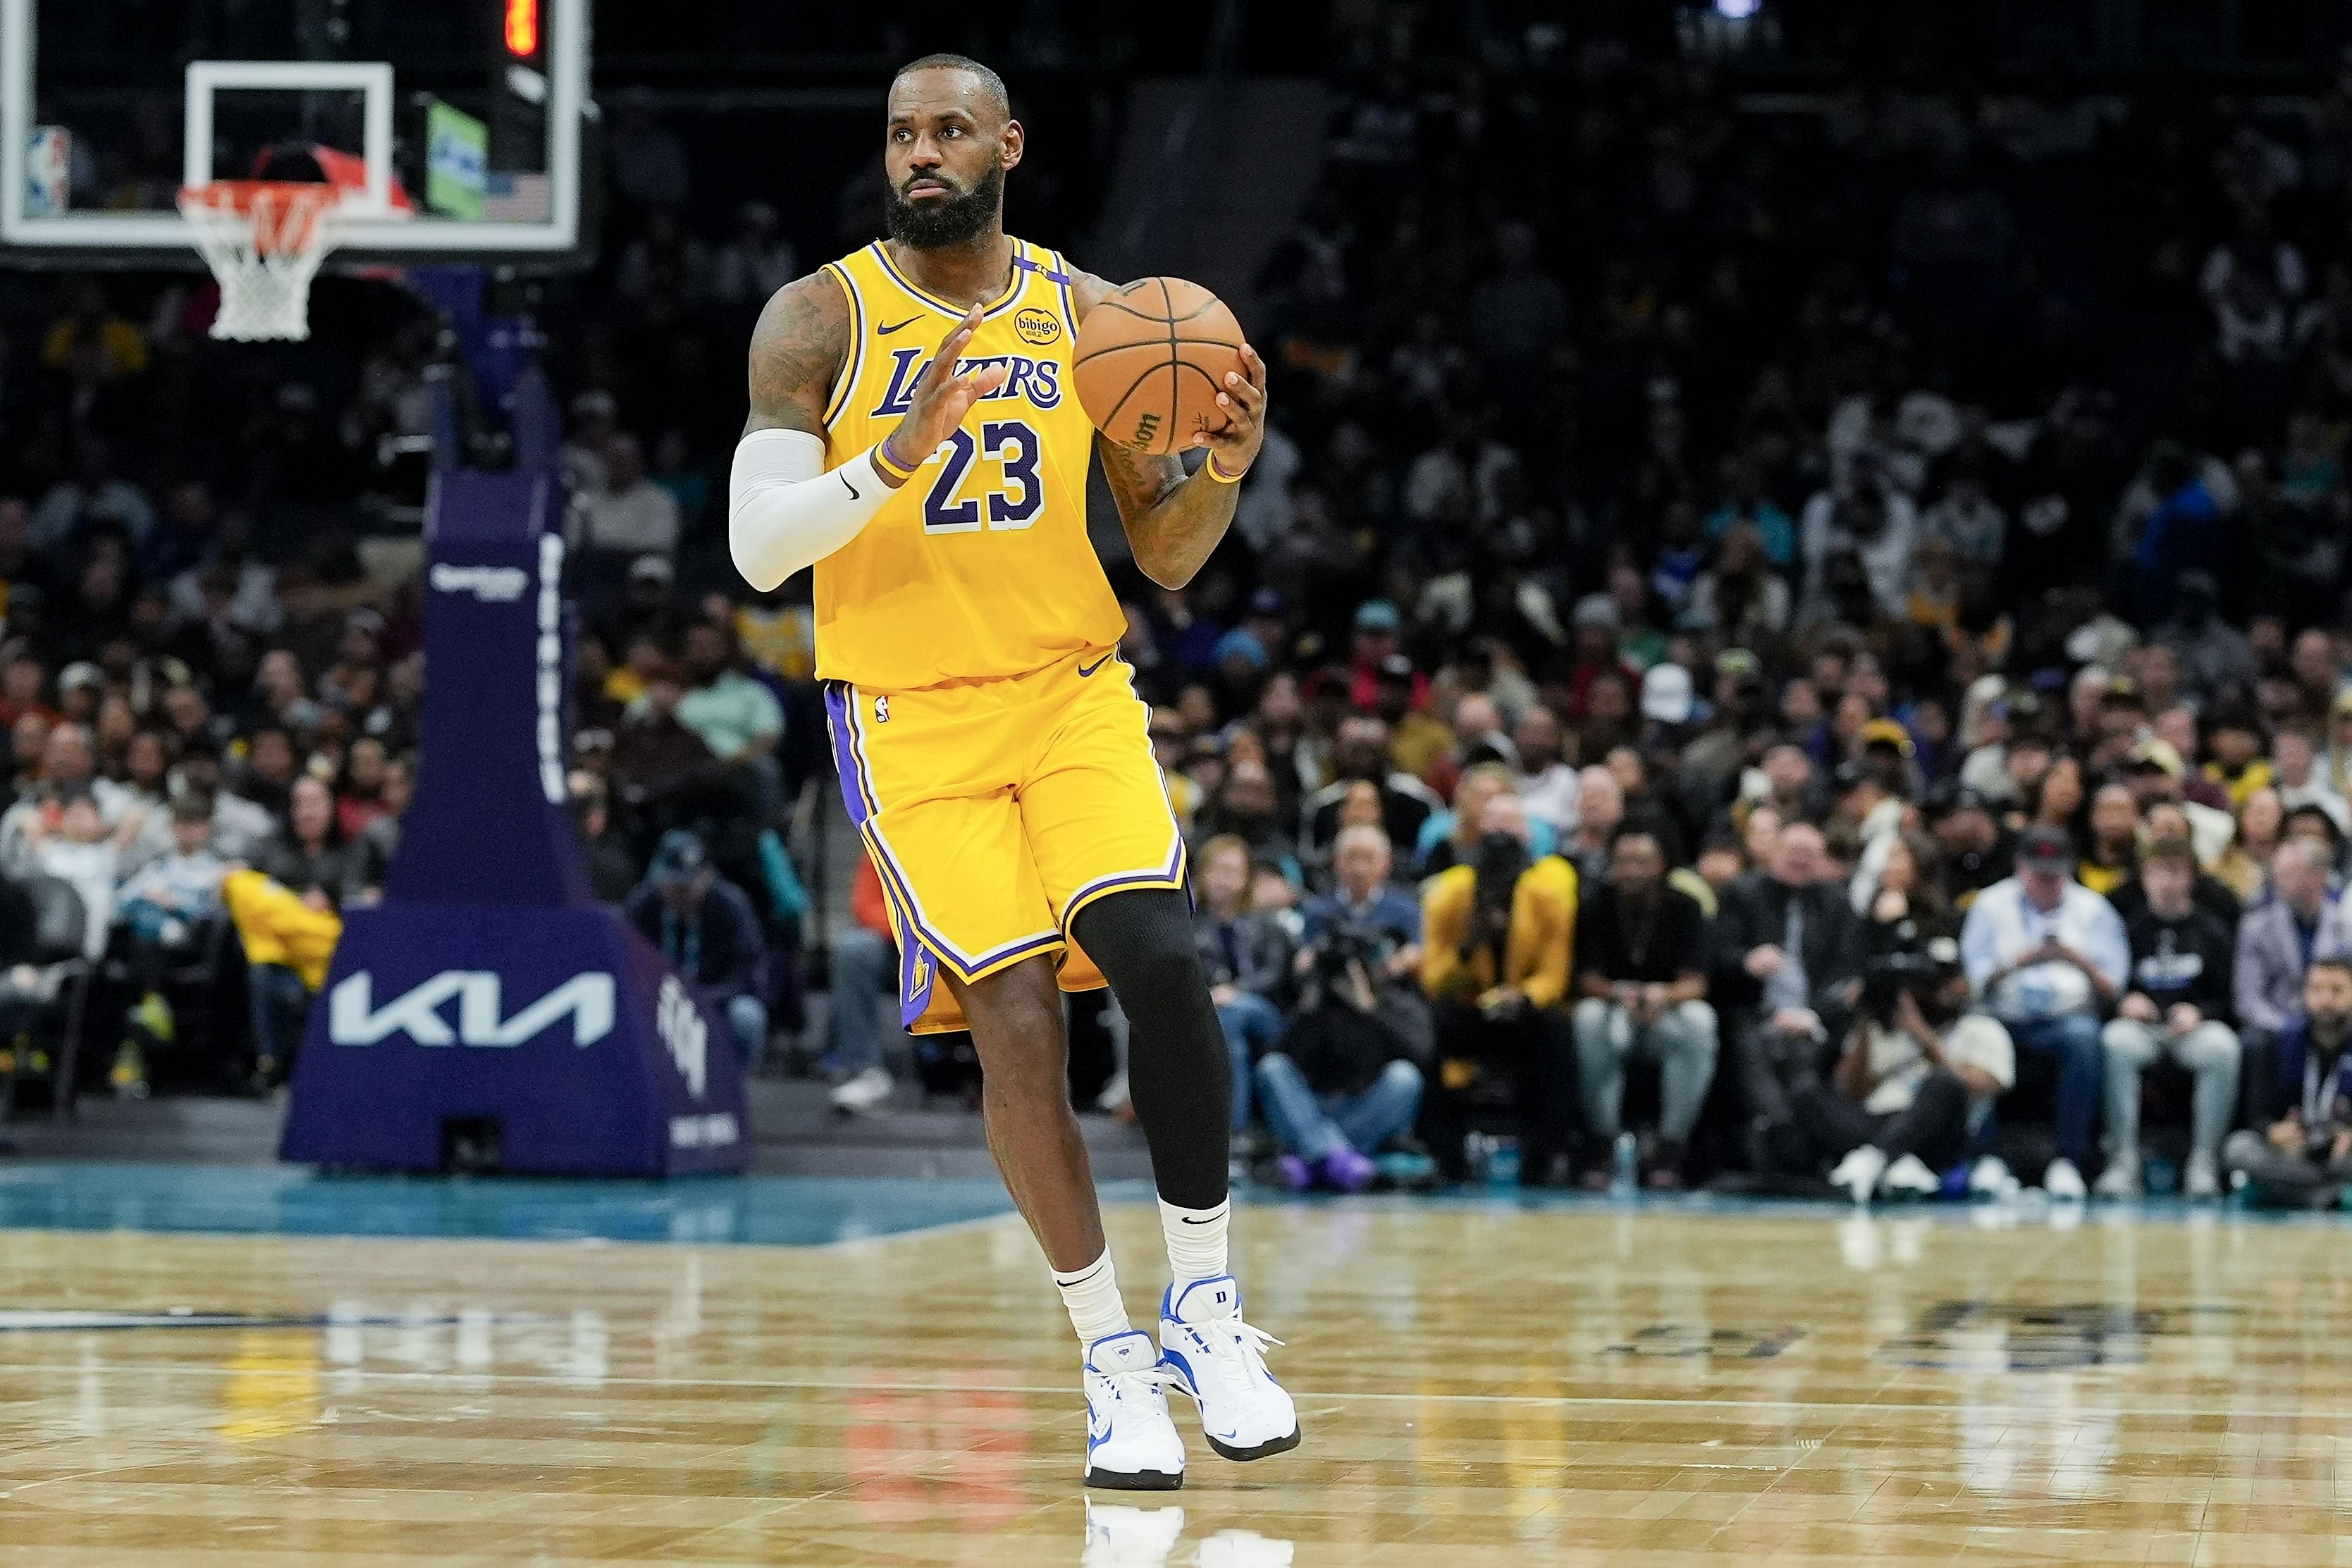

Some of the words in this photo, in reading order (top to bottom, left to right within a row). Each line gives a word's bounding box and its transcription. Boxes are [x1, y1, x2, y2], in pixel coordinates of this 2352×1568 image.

[1018, 317, 1058, 335] bibigo
[923, 420, 1045, 534] 23
[329, 970, 615, 1047] KIA
